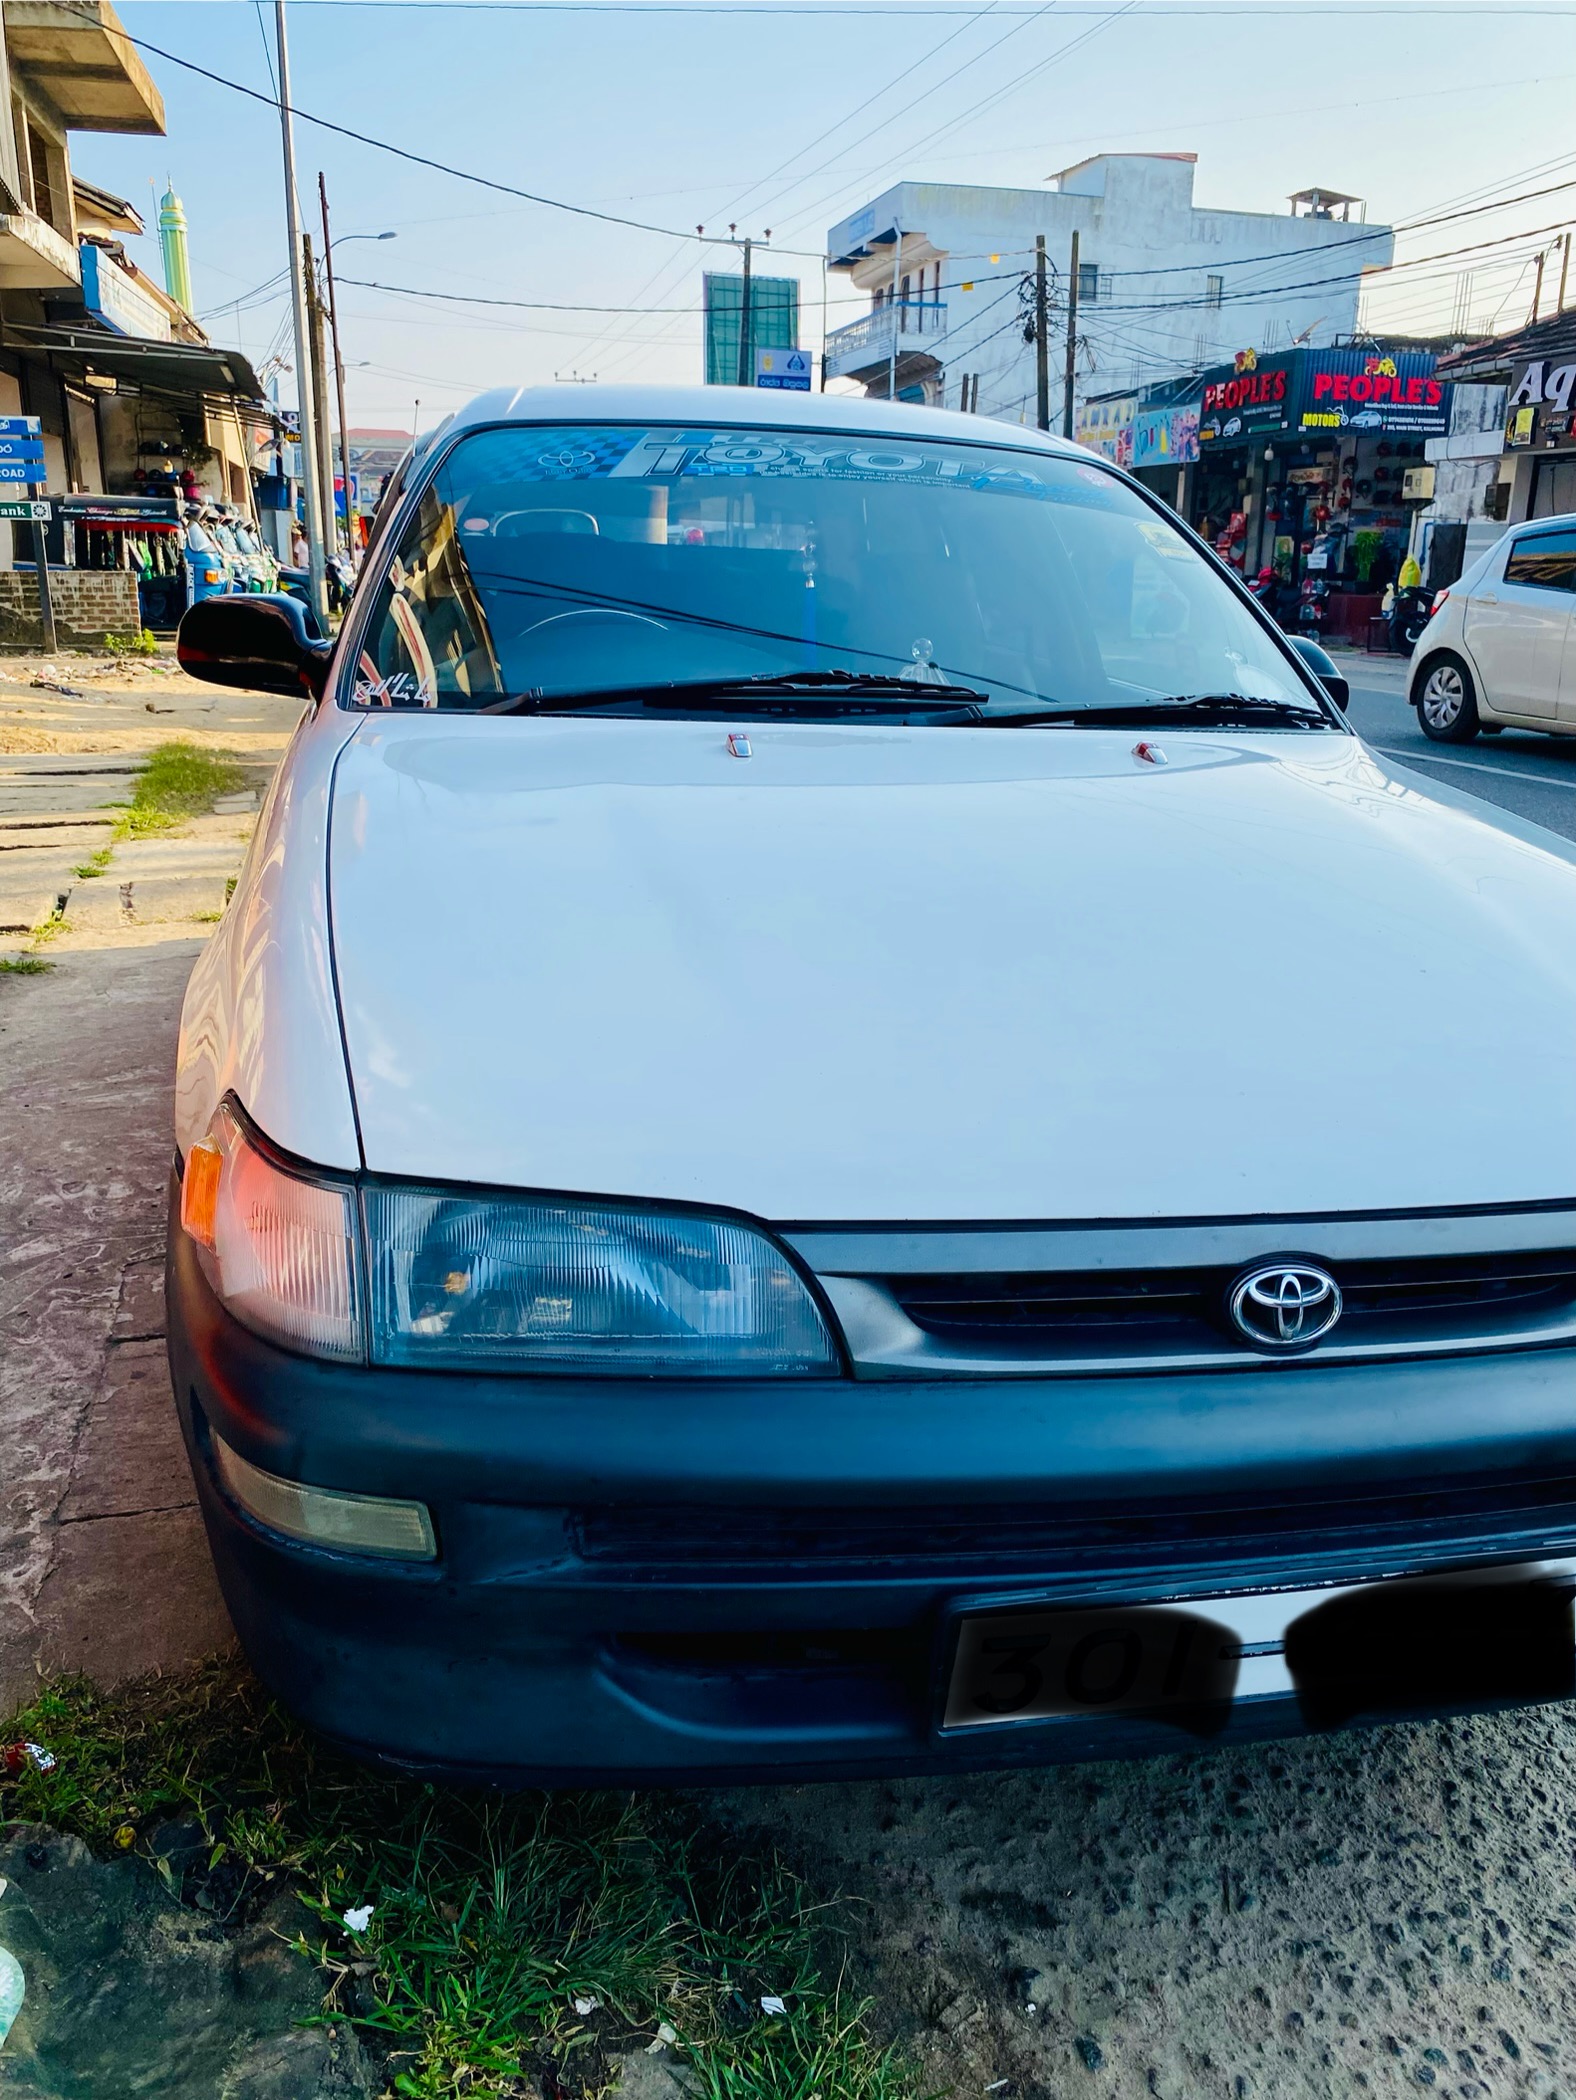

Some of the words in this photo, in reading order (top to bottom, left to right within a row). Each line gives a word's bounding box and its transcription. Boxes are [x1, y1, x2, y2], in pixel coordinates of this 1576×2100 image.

[1313, 373, 1442, 405] PEOPLE'S
[1302, 412, 1341, 428] MOTORS
[643, 441, 1048, 487] TOYOTA
[0, 468, 25, 478] OAD
[0, 505, 26, 516] ank
